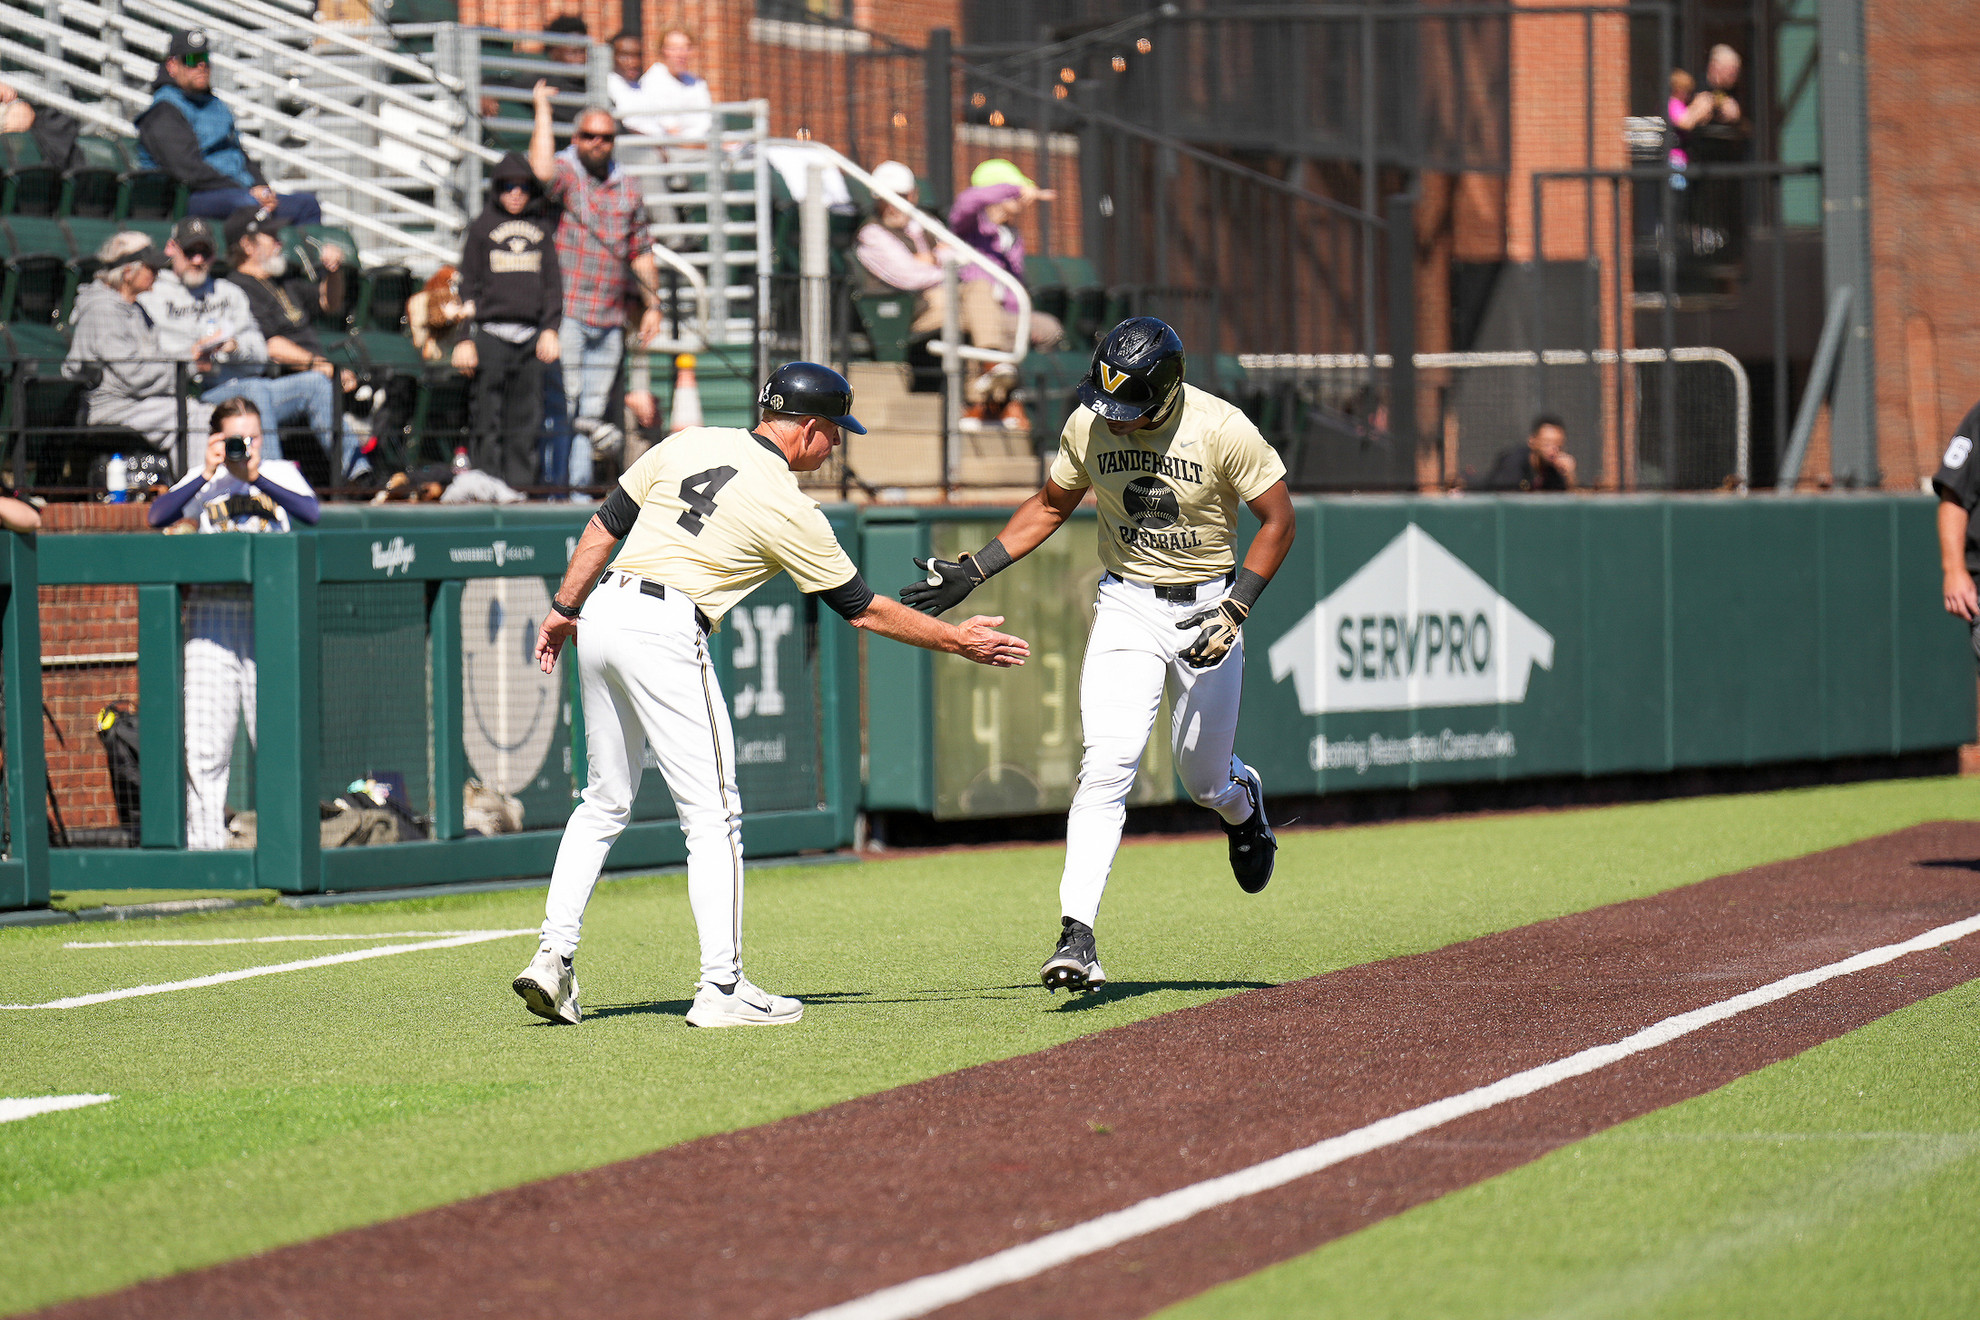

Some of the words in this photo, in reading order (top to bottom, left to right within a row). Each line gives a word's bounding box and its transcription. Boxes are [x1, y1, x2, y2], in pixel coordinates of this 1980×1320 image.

[1100, 360, 1131, 394] V
[1097, 450, 1203, 485] VANDERBILT
[1943, 435, 1974, 470] 6
[676, 465, 738, 537] 4
[1119, 525, 1202, 551] BASEBALL
[1336, 612, 1492, 681] SERVPRO
